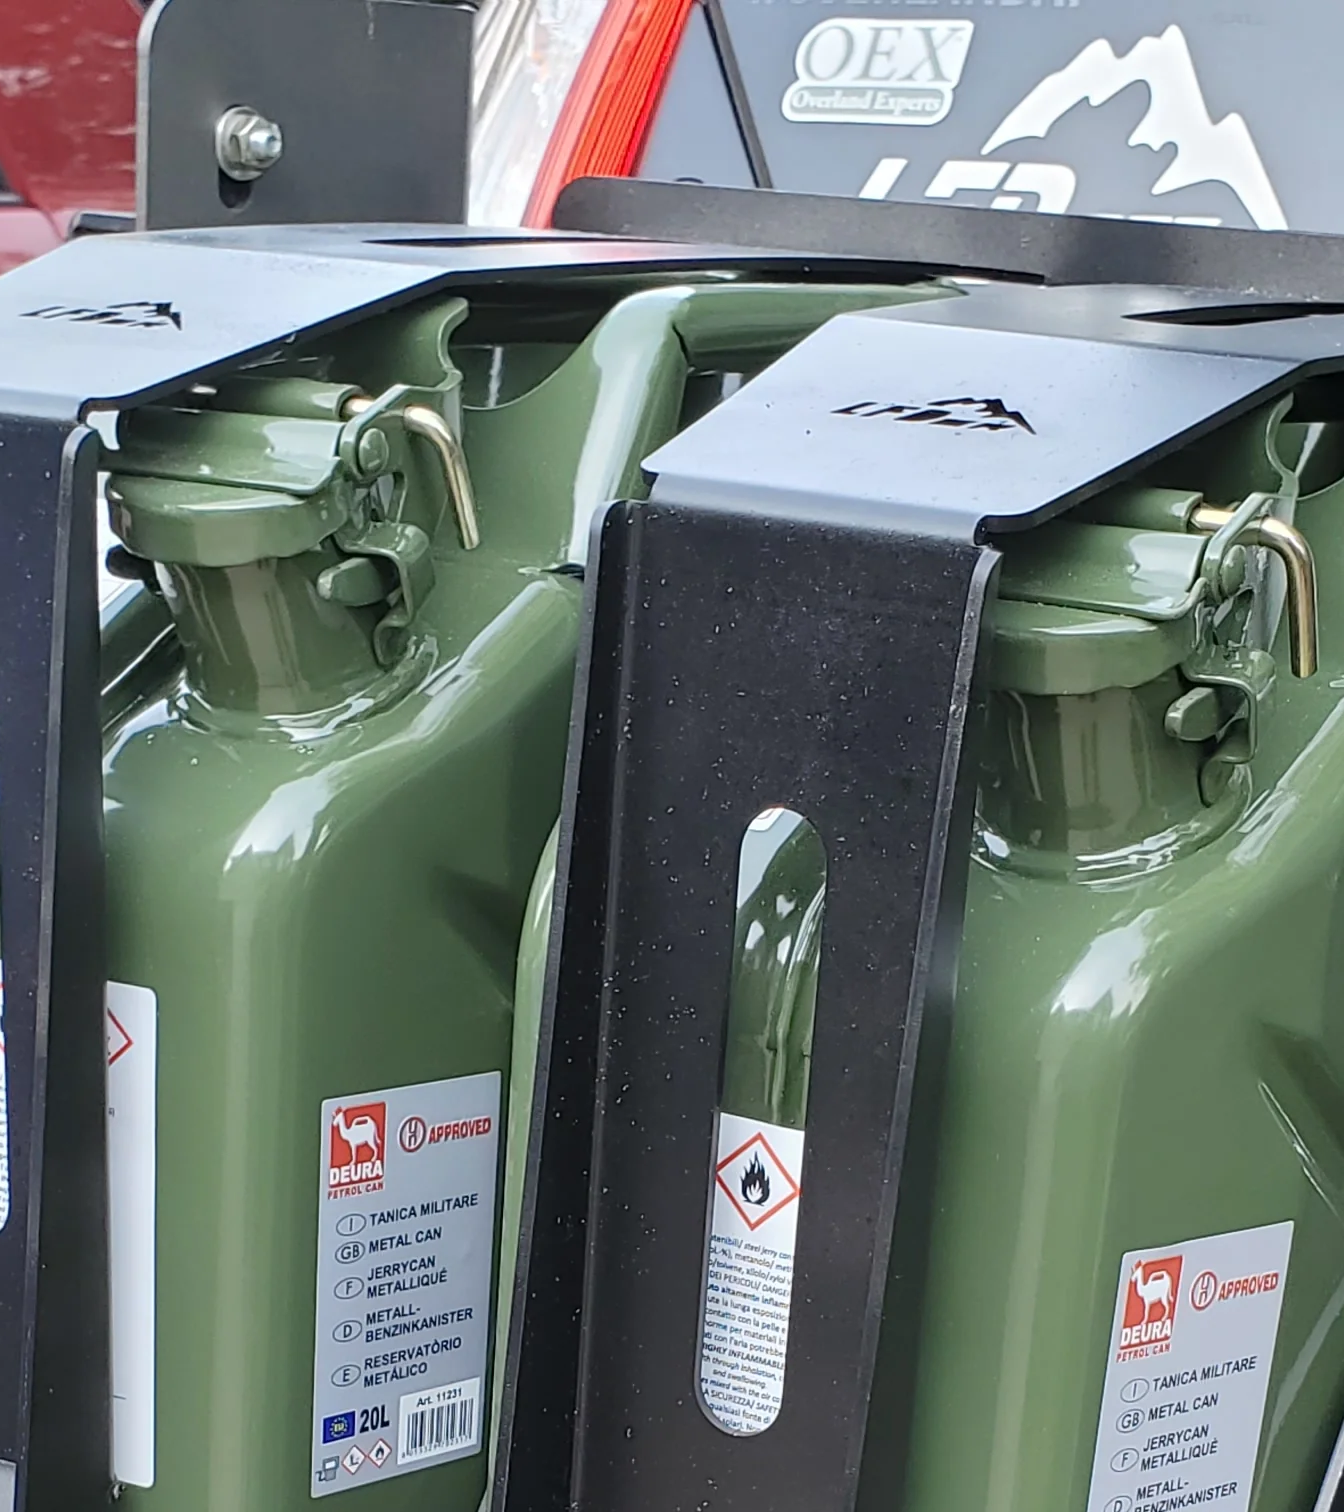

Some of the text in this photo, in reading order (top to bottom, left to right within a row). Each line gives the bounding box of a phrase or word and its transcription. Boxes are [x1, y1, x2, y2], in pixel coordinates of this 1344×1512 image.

[804, 25, 966, 83] OEX
[792, 90, 942, 116] Overland Experts
[428, 1117, 491, 1144] APPROVED
[329, 1160, 383, 1186] DEURA
[328, 1181, 384, 1200] PETROL CAN
[370, 1206, 416, 1226] TANICA
[420, 1193, 478, 1215] MILITARE
[340, 1227, 442, 1260] GB METAL CAN
[368, 1256, 436, 1280] JERRYCAN
[710, 1270, 722, 1280] DEI
[724, 1274, 761, 1290] PERICOLI/
[1219, 1273, 1279, 1301] APPROVED
[721, 1286, 759, 1302] altamente
[366, 1303, 421, 1326] METALL-
[731, 1300, 750, 1313] lunga
[365, 1308, 473, 1343] BENZINKANISTER
[730, 1326, 742, 1334] per
[744, 1330, 777, 1343] materiali
[738, 1316, 751, 1325] con
[754, 1318, 760, 1326] la
[762, 1322, 780, 1333] pelle
[1120, 1318, 1172, 1347] DEURA
[715, 1334, 727, 1343] con
[729, 1336, 747, 1348] l'aria
[712, 1357, 739, 1370] through
[1117, 1343, 1171, 1363] PETROL CAN
[713, 1369, 726, 1377] and
[1152, 1369, 1197, 1392] TANICA
[1200, 1356, 1257, 1380] MILITARE
[416, 1388, 462, 1407] Art. 11231
[710, 1378, 730, 1389] mixed
[732, 1385, 747, 1394] with
[749, 1388, 759, 1397] the
[711, 1390, 755, 1409] SICUREZZA/
[1121, 1393, 1219, 1429] GB METAL CAN
[359, 1404, 390, 1433] 20L
[743, 1409, 761, 1422] fonte
[1143, 1424, 1209, 1453] JERRYCAN
[1136, 1477, 1189, 1501] METALL-
